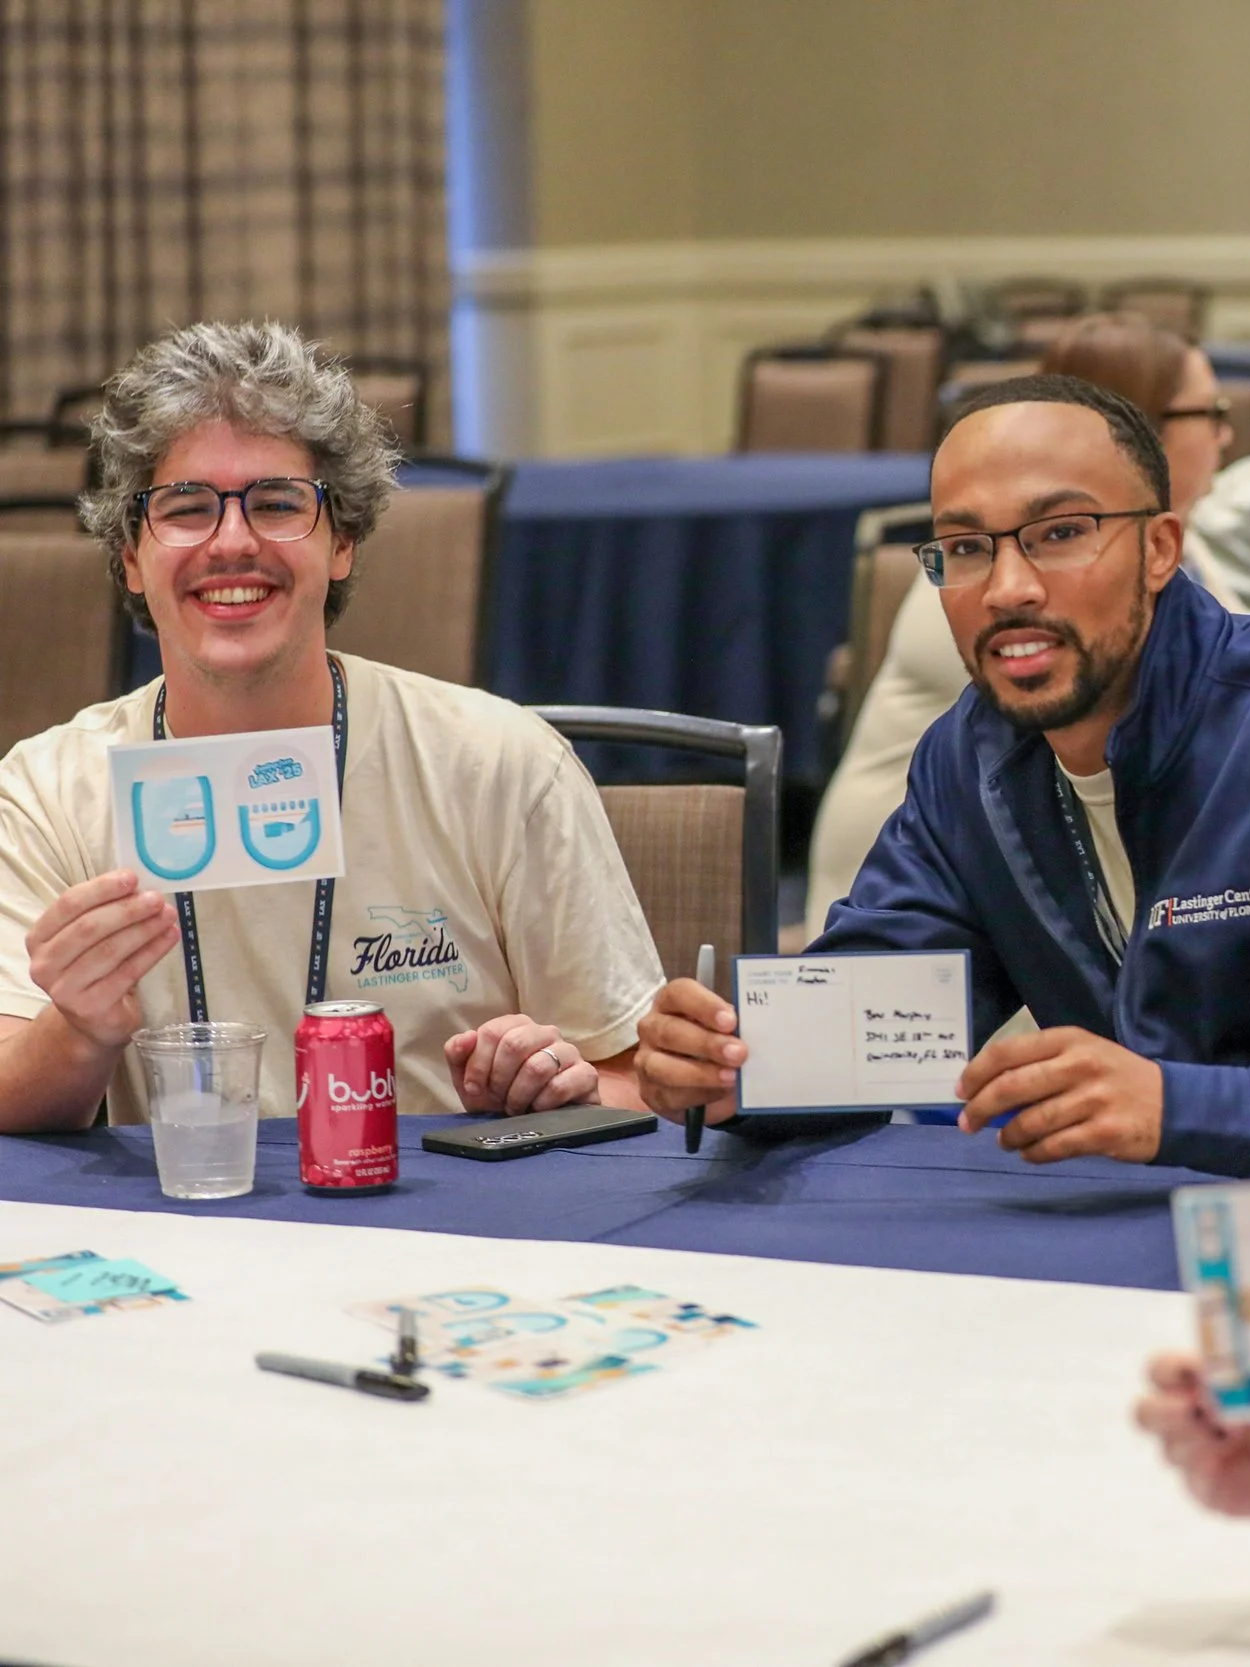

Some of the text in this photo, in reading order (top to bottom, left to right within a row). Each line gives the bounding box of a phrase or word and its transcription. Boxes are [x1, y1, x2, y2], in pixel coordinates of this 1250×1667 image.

[1172, 894, 1224, 911] Lastinger
[1172, 910, 1220, 925] UNIVERSITY
[350, 927, 459, 975] Florida
[357, 963, 463, 989] LASTINGER CENTER
[746, 991, 768, 1005] Hi!
[331, 1103, 373, 1112] sparkling
